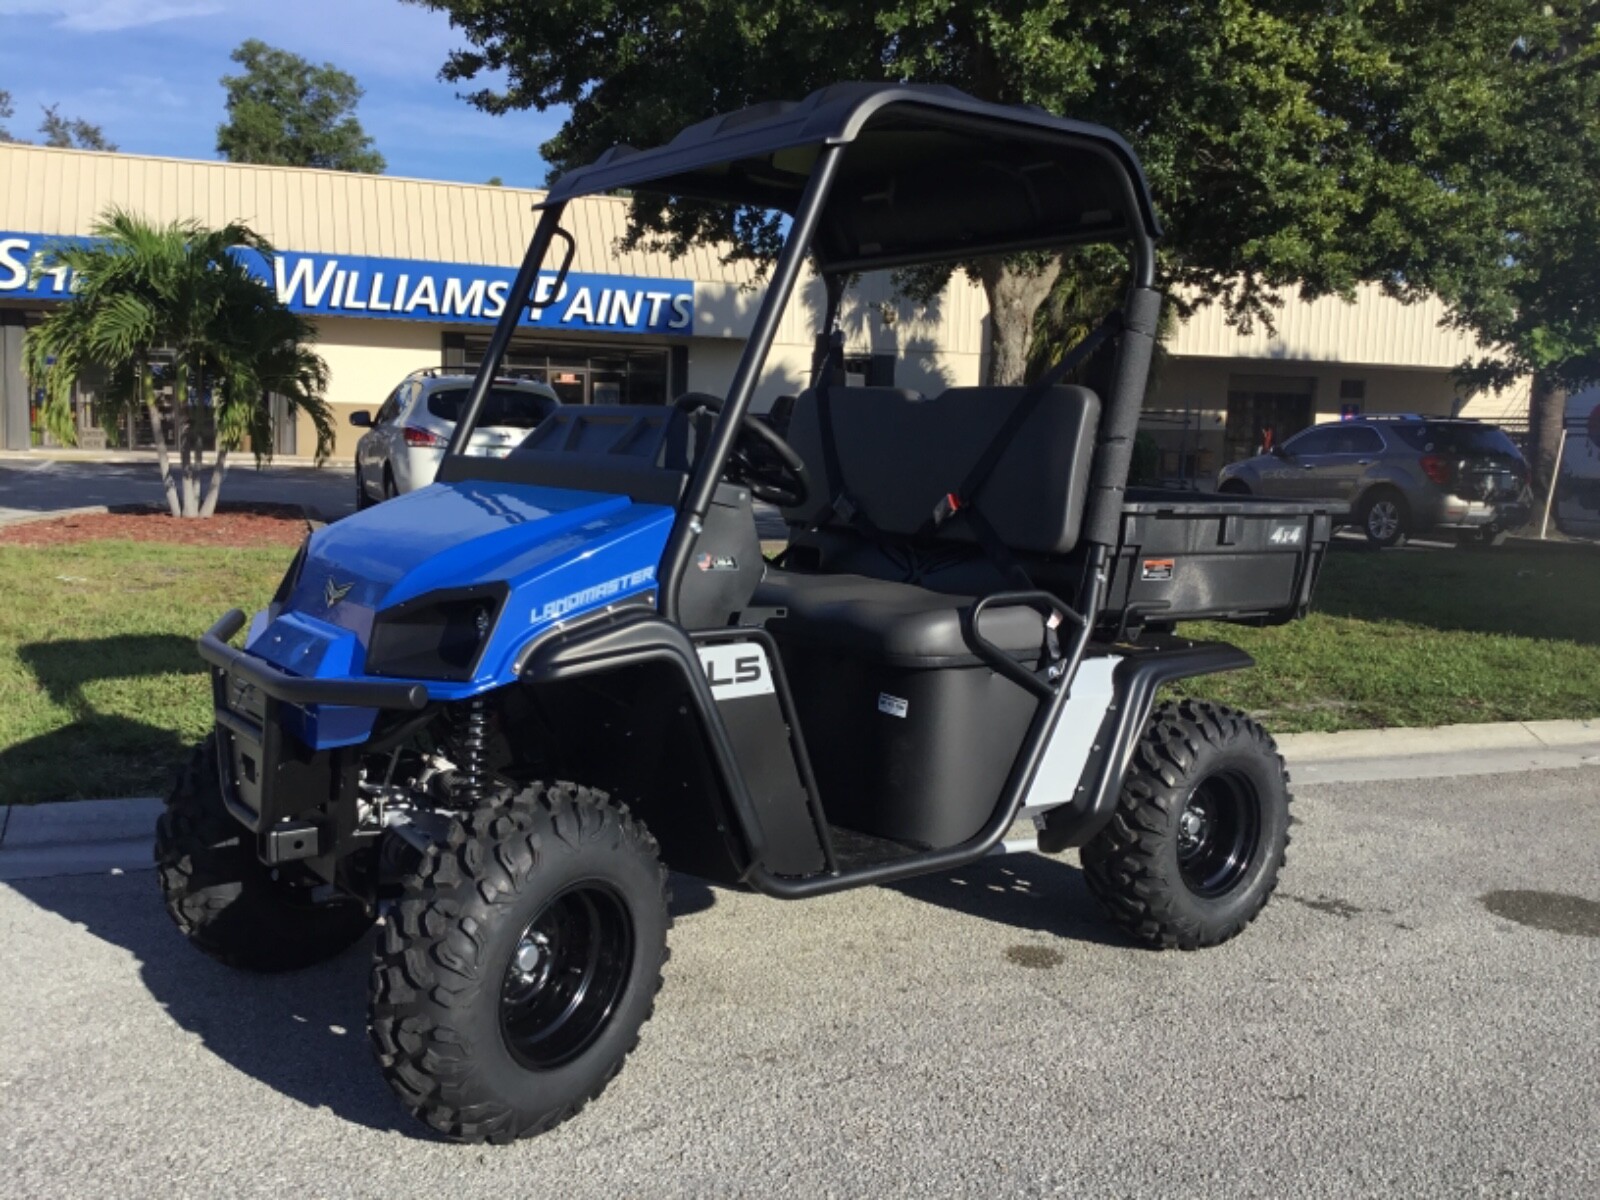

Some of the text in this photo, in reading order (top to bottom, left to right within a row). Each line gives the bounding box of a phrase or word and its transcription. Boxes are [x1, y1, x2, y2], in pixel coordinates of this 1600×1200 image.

[274, 256, 509, 318] WILLIAMS
[530, 275, 693, 329] PAINTS
[530, 565, 656, 624] LANDMASTER
[707, 655, 761, 687] L5
